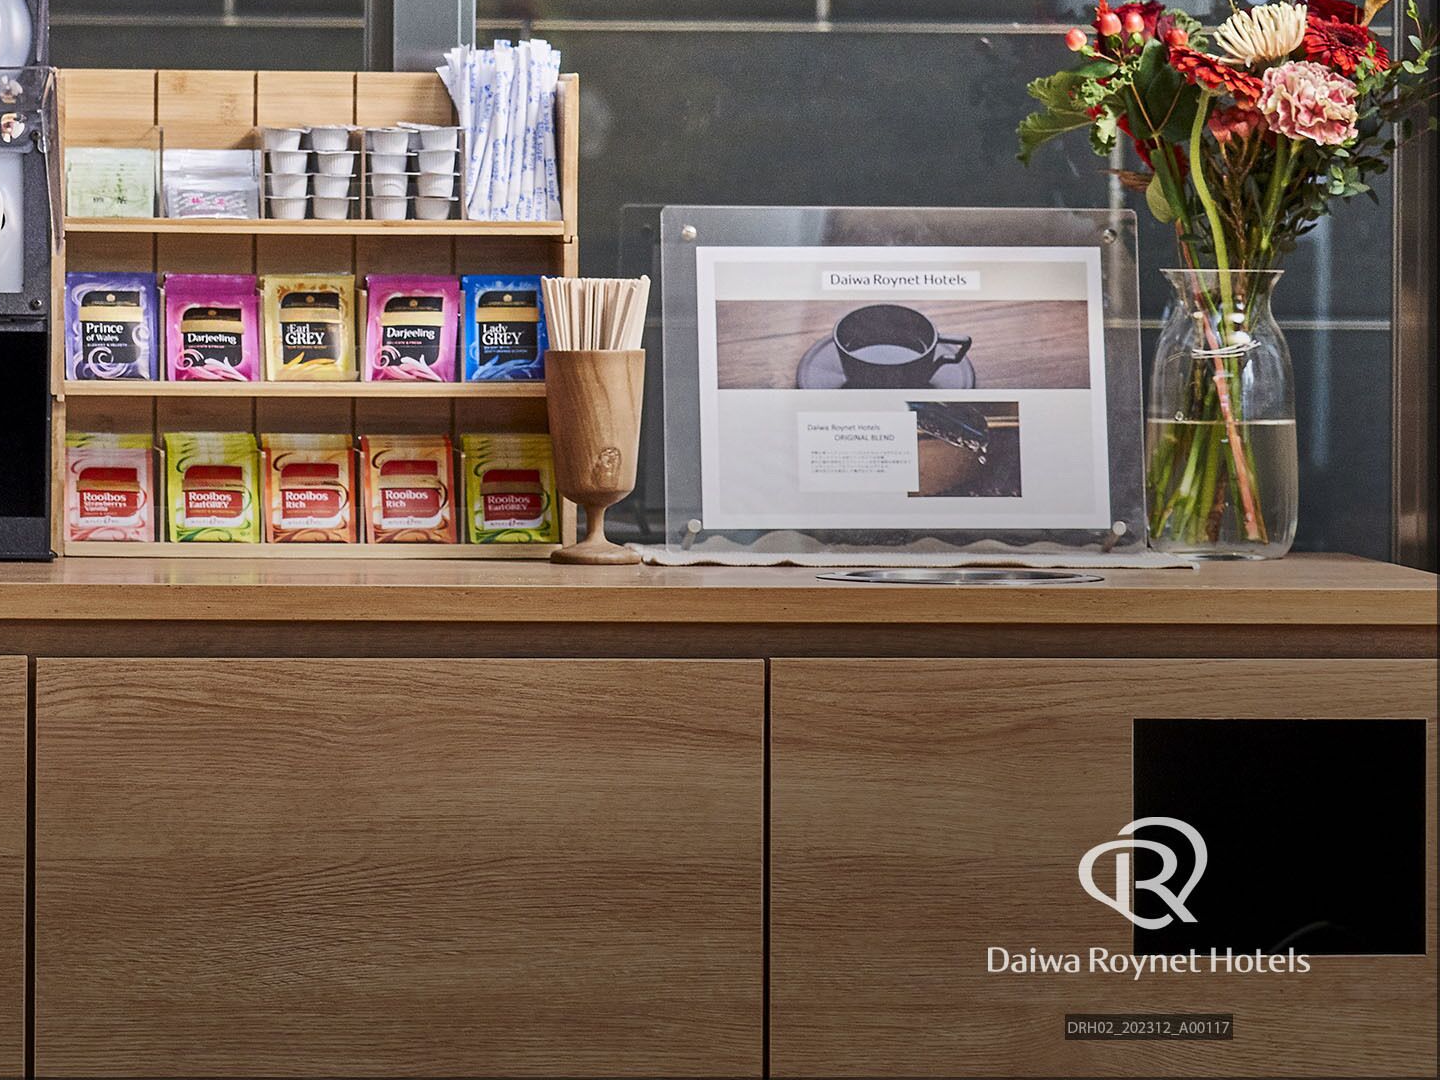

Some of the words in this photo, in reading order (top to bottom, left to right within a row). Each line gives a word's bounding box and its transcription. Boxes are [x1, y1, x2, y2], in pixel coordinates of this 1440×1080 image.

[830, 274, 870, 286] Daiwa
[873, 274, 920, 288] Roynet
[924, 274, 967, 286] Hotels
[86, 322, 124, 334] Prince
[290, 324, 310, 334] Earl
[482, 324, 508, 334] Lady
[86, 334, 96, 342] of
[96, 334, 120, 342] Wales
[285, 332, 324, 345] GREY
[386, 327, 436, 340] Darjeeling
[482, 332, 522, 345] GREY
[187, 333, 237, 345] Darjeeling
[832, 424, 856, 432] Roynet
[83, 492, 127, 502] Rooibos
[188, 492, 232, 502] Rooibos
[286, 492, 328, 501] Rooibos
[385, 490, 428, 500] Rooibos
[488, 496, 530, 504] Rooibos
[286, 500, 306, 509] Rich
[386, 500, 406, 508] Rich
